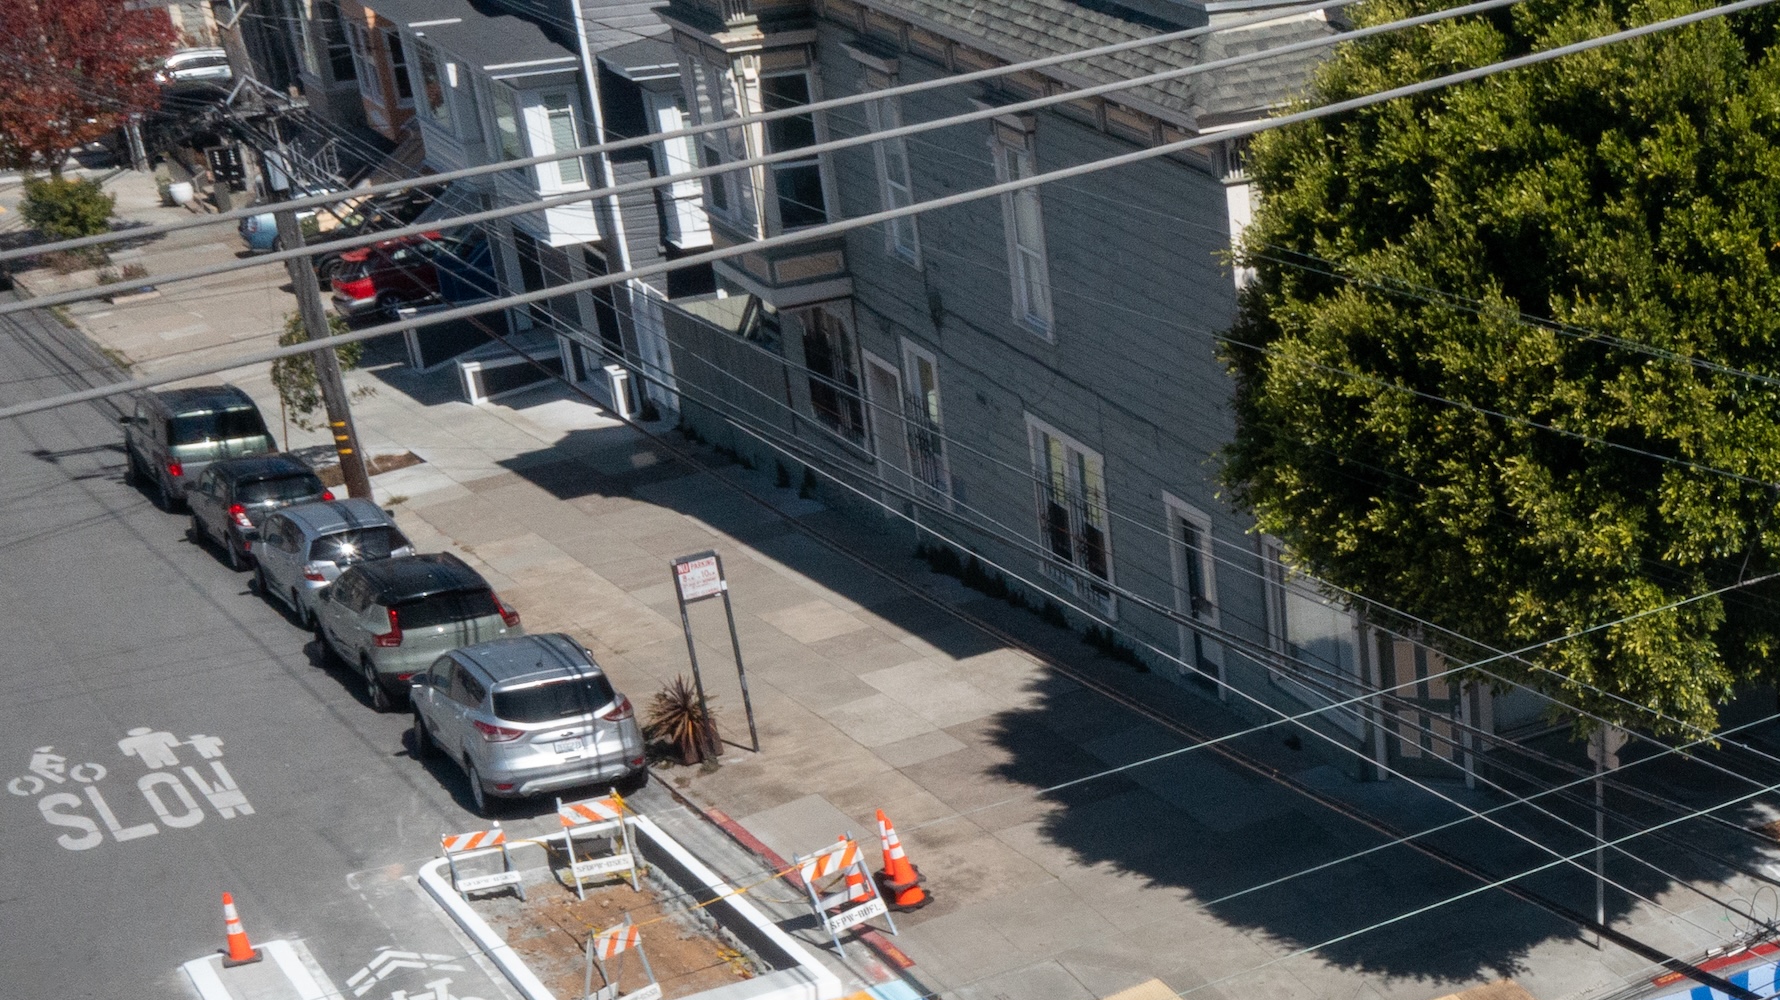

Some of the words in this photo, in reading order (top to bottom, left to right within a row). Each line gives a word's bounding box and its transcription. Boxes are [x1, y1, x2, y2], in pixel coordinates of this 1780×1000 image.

[677, 562, 690, 574] NO
[691, 558, 715, 570] PARKING
[38, 760, 256, 850] SLOW
